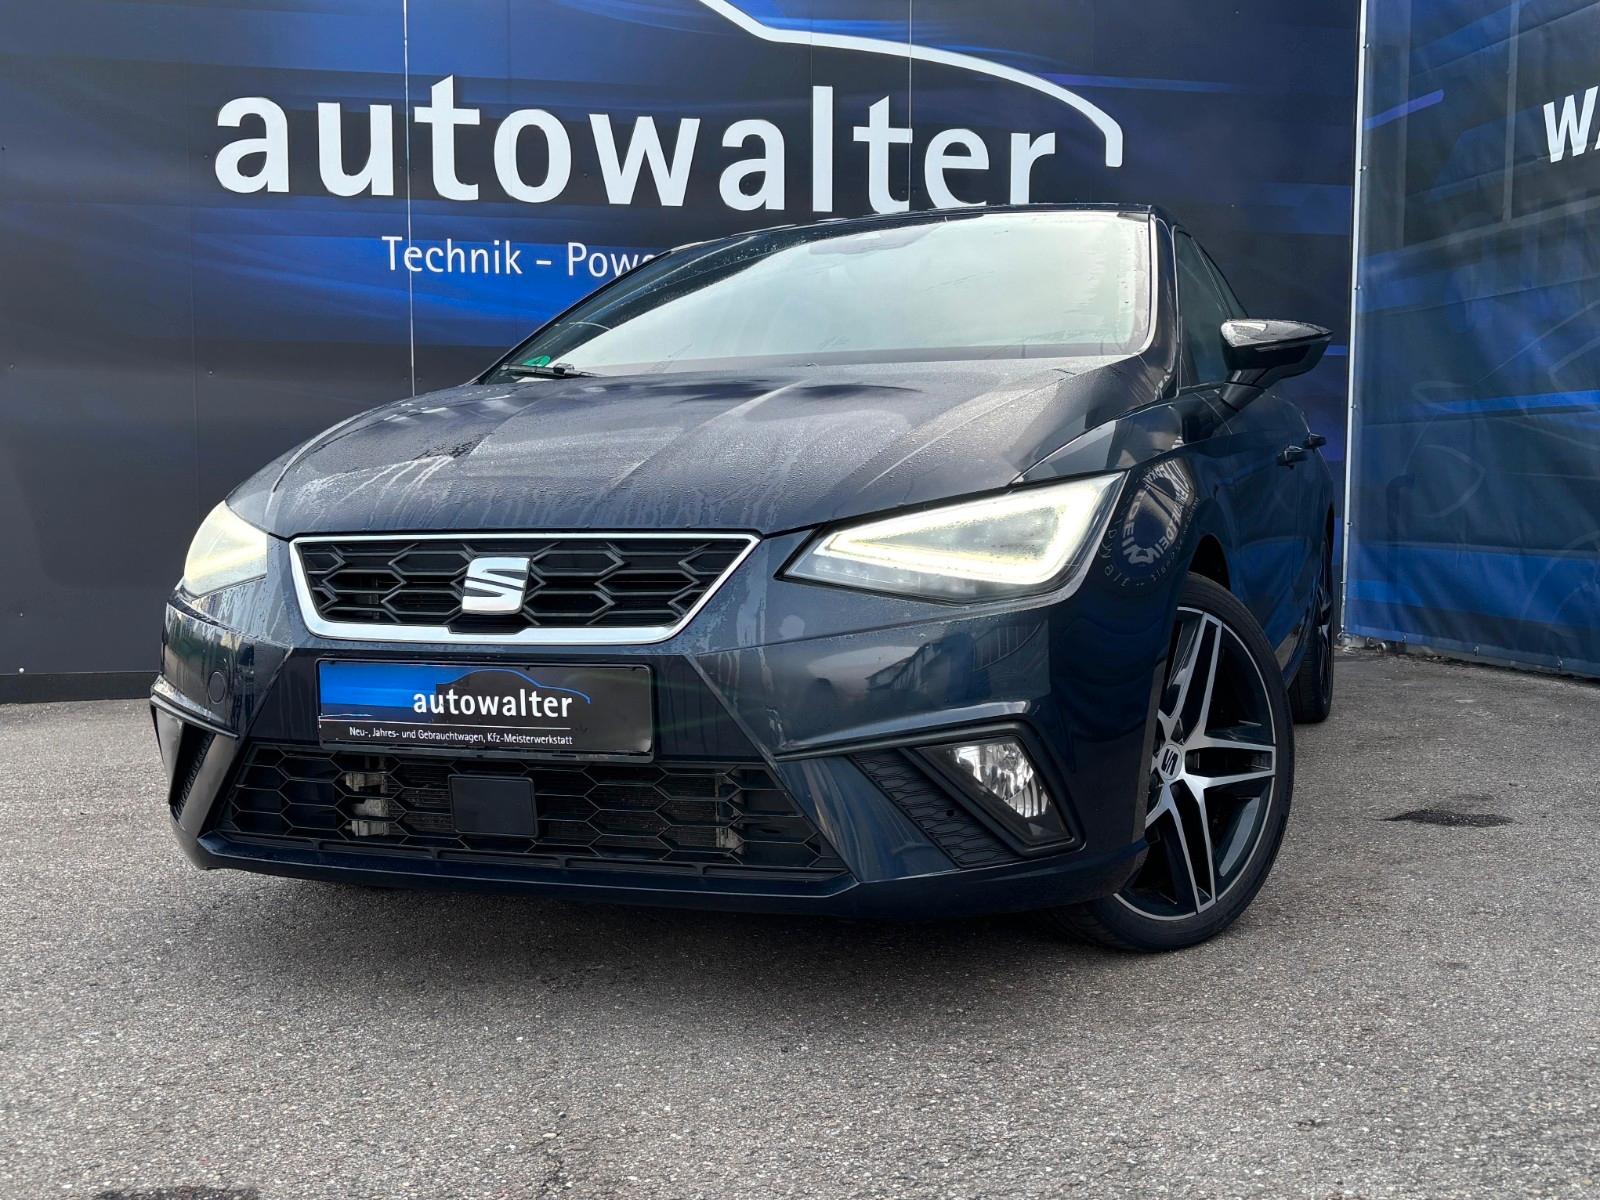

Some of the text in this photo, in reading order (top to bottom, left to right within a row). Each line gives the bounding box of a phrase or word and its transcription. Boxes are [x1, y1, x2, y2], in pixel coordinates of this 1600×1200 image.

[214, 75, 1056, 213] autowalter
[1543, 86, 1600, 163] W
[381, 235, 523, 274] Technik
[413, 688, 573, 718] autowalter
[349, 726, 573, 745] Neu-, Jahres- und Gebrauchtwagen, Kfz-Meisterwerkstatt
